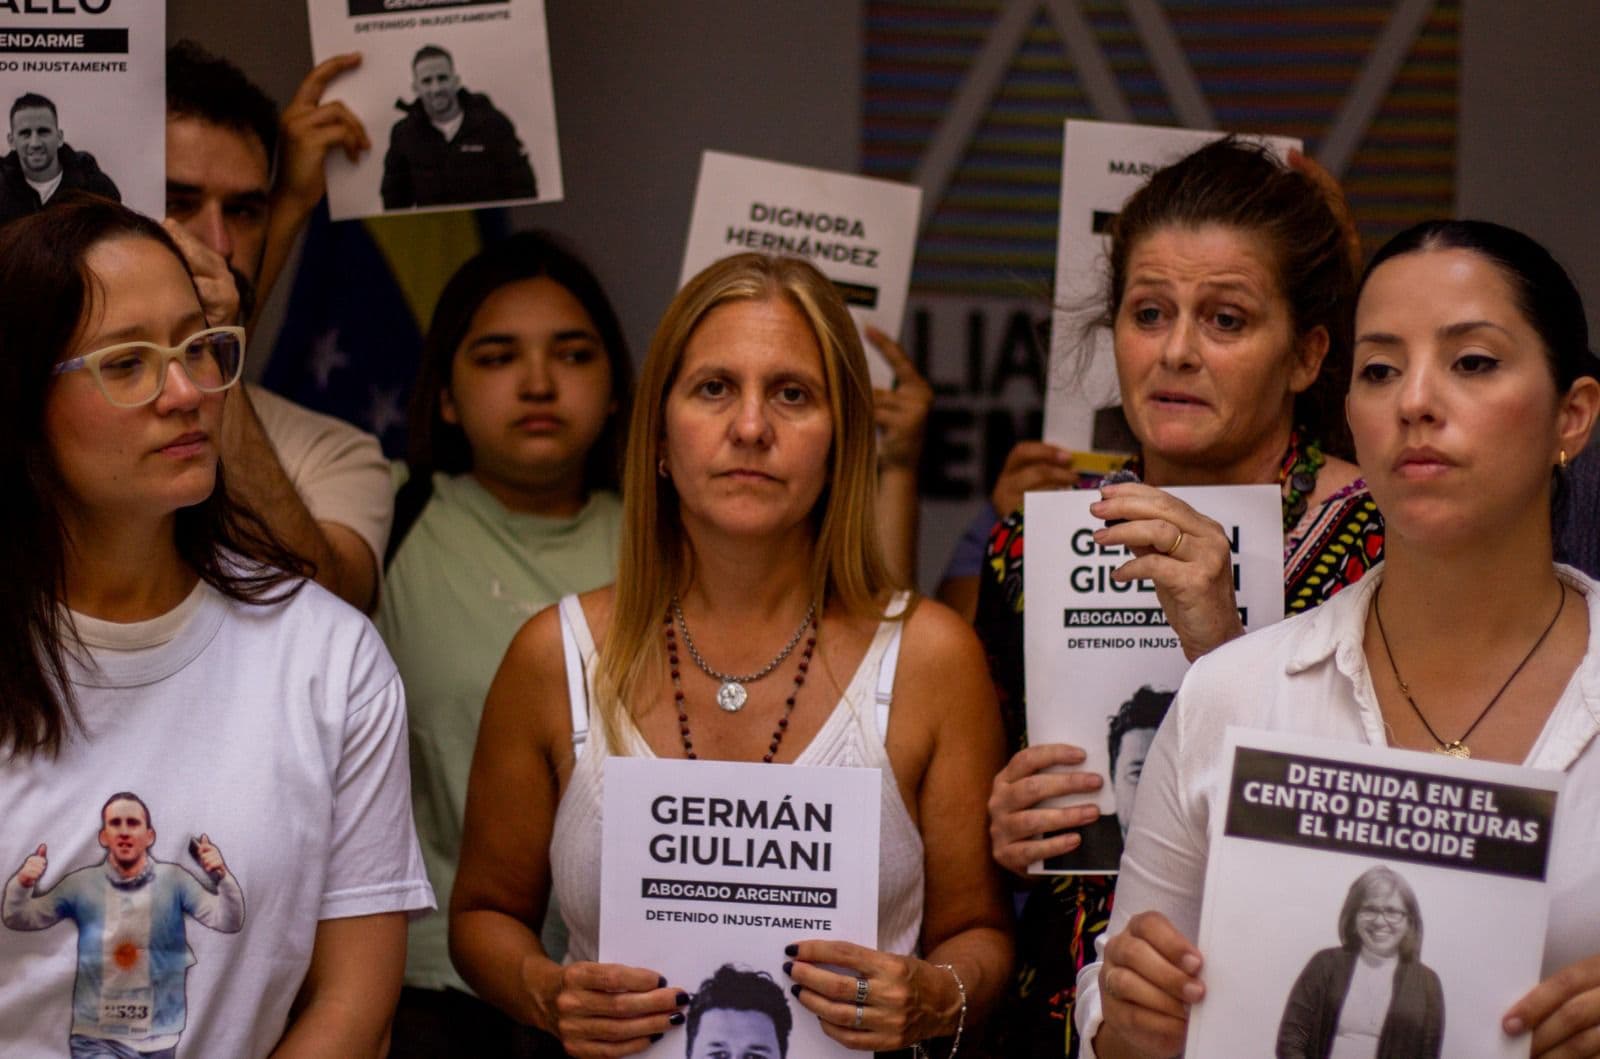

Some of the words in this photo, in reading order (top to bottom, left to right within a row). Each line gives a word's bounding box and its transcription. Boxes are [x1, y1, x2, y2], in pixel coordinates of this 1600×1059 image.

[22, 61, 127, 72] INJUSTAMENTE
[750, 202, 866, 239] DIGNORA
[726, 225, 880, 268] HERNÁNDEZ
[1068, 611, 1147, 625] ABOGADO
[1067, 638, 1135, 649] DETENIDO
[1288, 763, 1419, 802] DETENIDA
[1426, 784, 1463, 808] EN
[1470, 790, 1499, 813] EL
[651, 795, 833, 832] GERMÁN
[1243, 782, 1349, 815] CENTRO
[1356, 798, 1390, 822] DE
[1398, 804, 1539, 843] TORTURAS
[649, 834, 832, 872] GIULIANI
[1299, 814, 1328, 837] EL
[1335, 820, 1476, 859] HELICOIDE
[647, 882, 731, 899] ABOGADO
[735, 887, 832, 905] ARGENTINO
[645, 909, 719, 924] DETENIDO
[723, 914, 832, 931] INJUSTAMENTE
